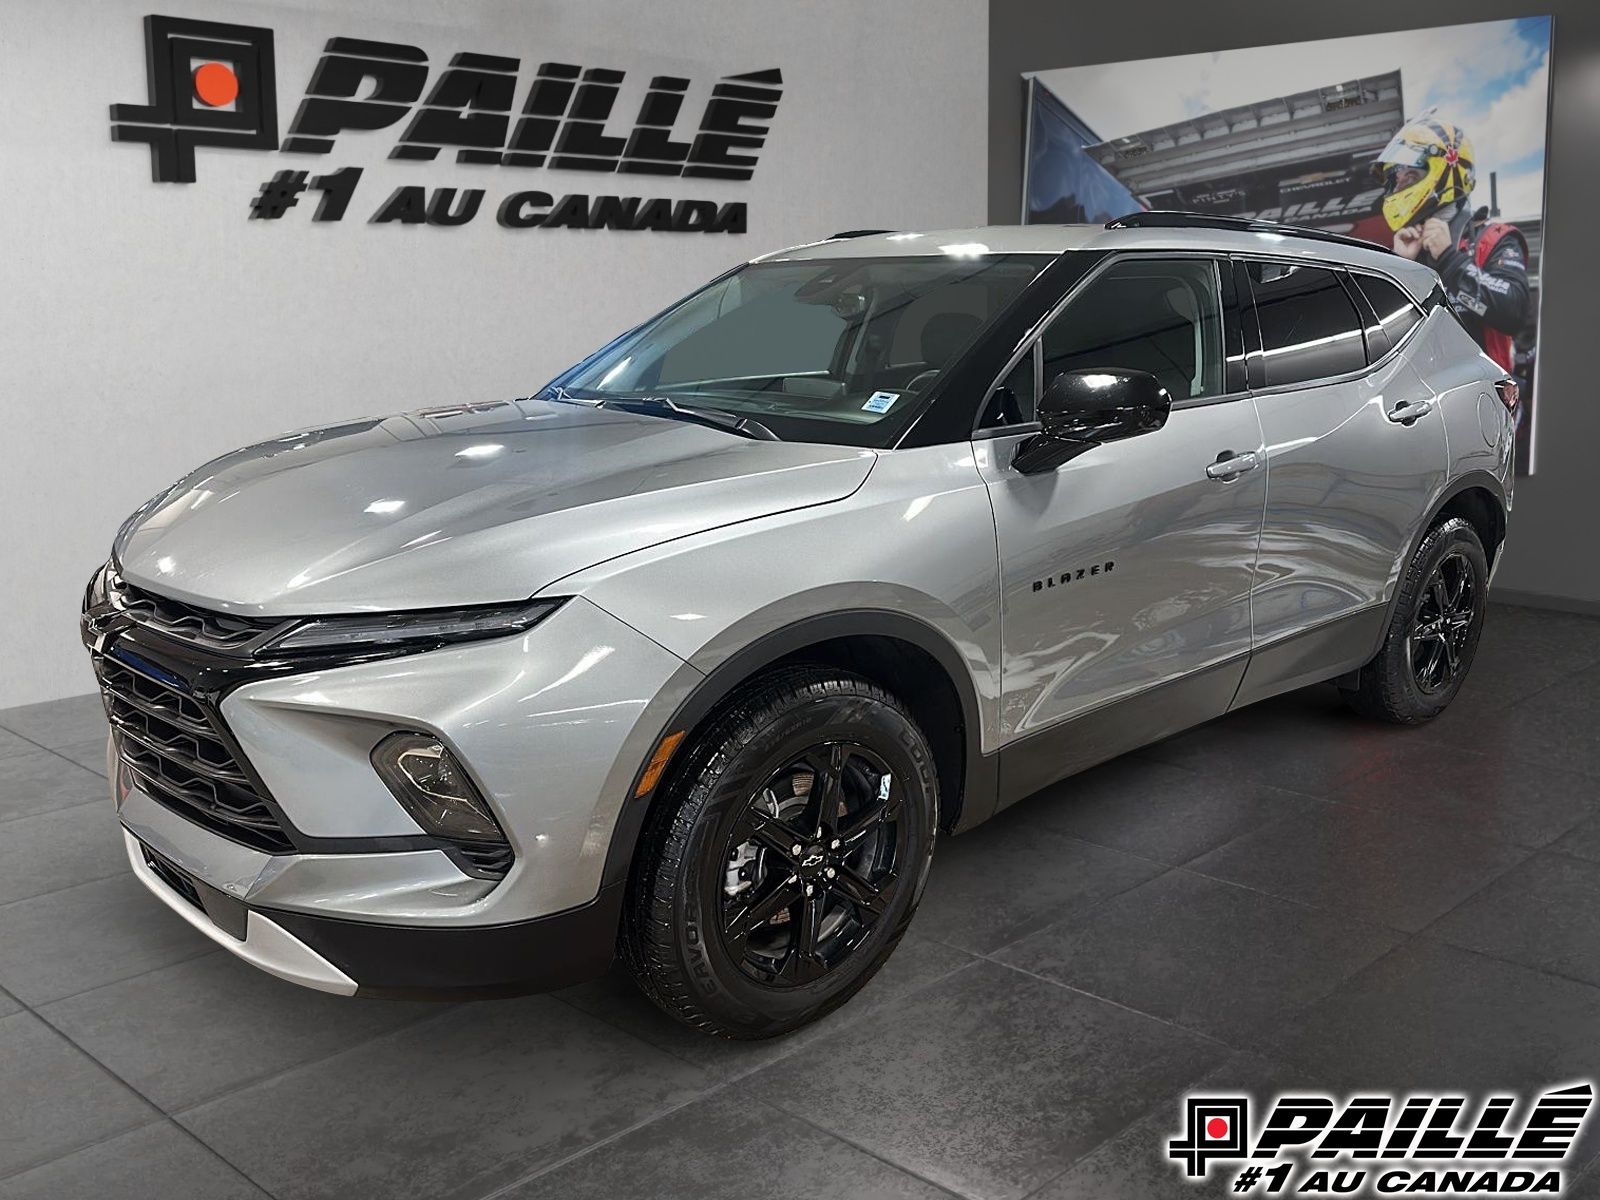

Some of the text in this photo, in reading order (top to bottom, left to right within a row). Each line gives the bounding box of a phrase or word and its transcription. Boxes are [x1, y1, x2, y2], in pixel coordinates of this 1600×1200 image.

[280, 37, 783, 181] PAILLÉ
[248, 167, 748, 234] #1 AU CANADA
[1279, 177, 1351, 194] CHEVROLET
[1283, 206, 1372, 224] CANADA
[1032, 561, 1115, 593] BLAZER
